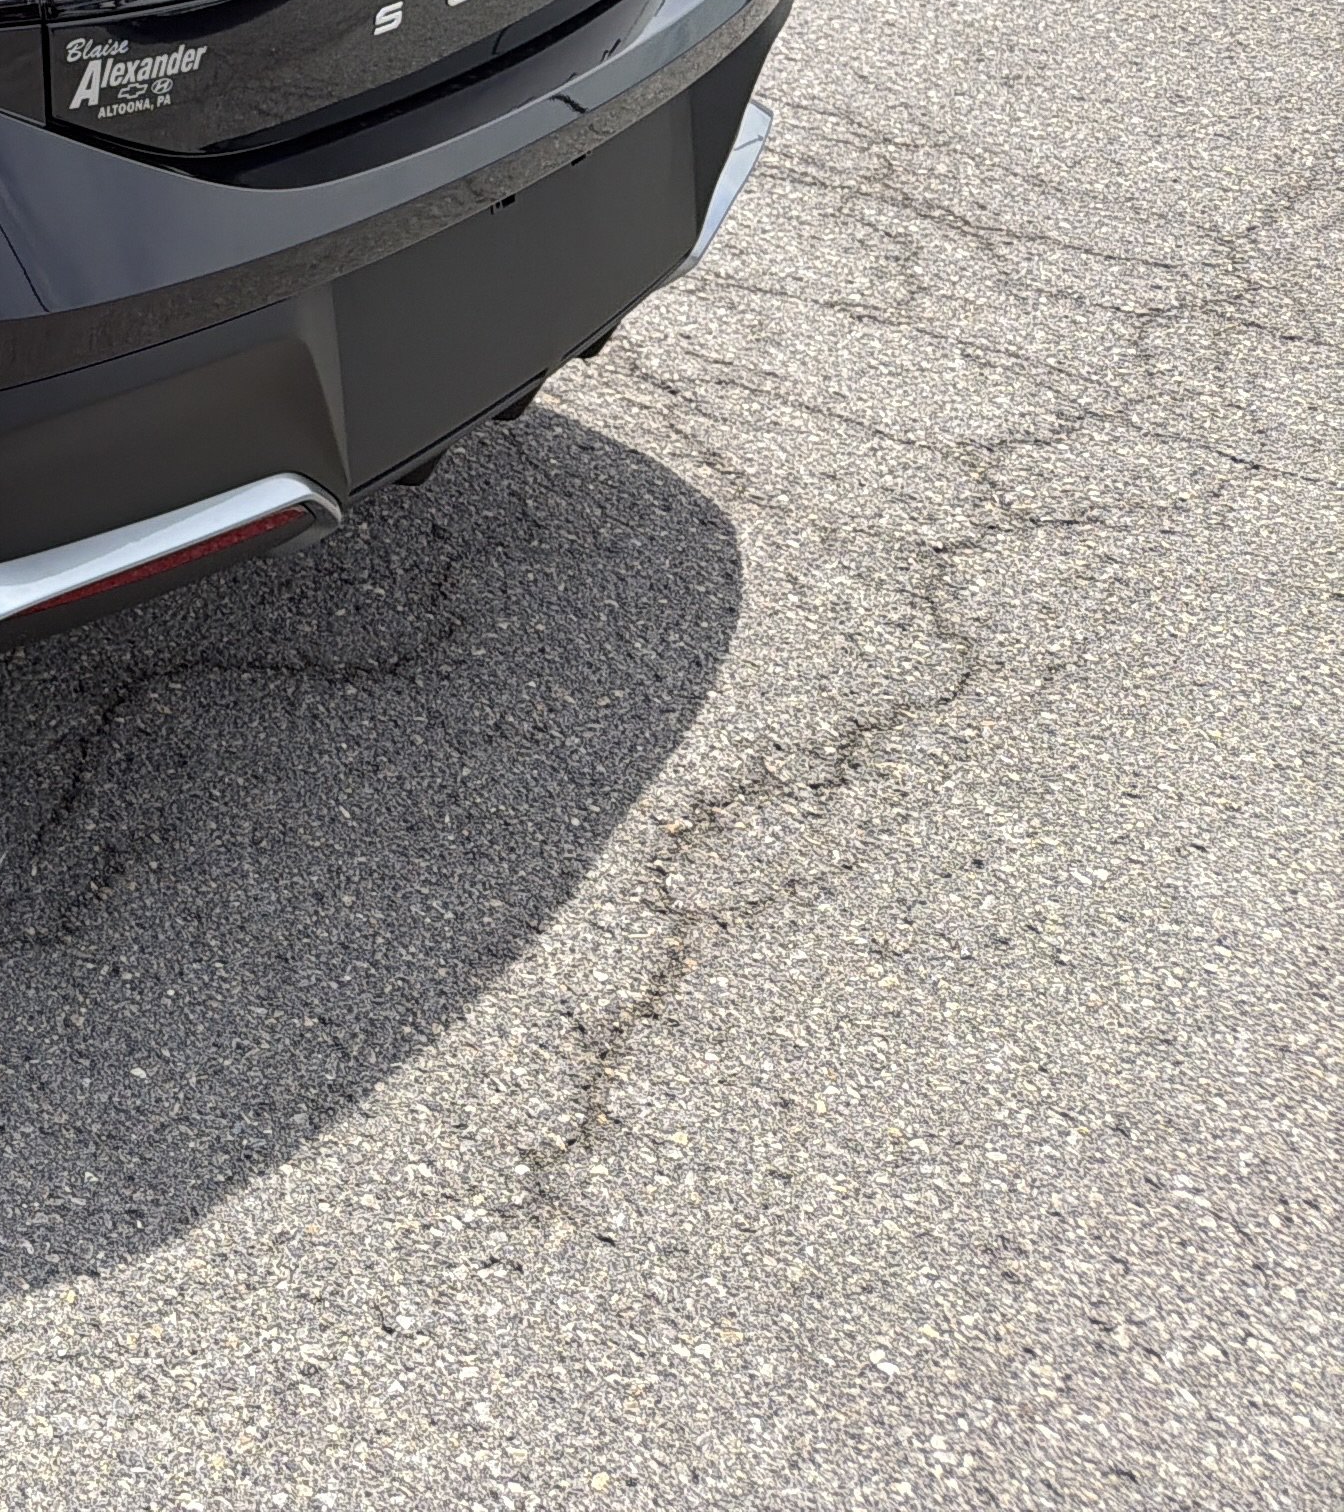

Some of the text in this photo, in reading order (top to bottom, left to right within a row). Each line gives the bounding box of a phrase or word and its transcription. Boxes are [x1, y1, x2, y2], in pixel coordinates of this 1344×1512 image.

[66, 37, 130, 63] Blaise
[69, 44, 209, 110] Alexander
[97, 94, 172, 120] ALTOONA, PA
